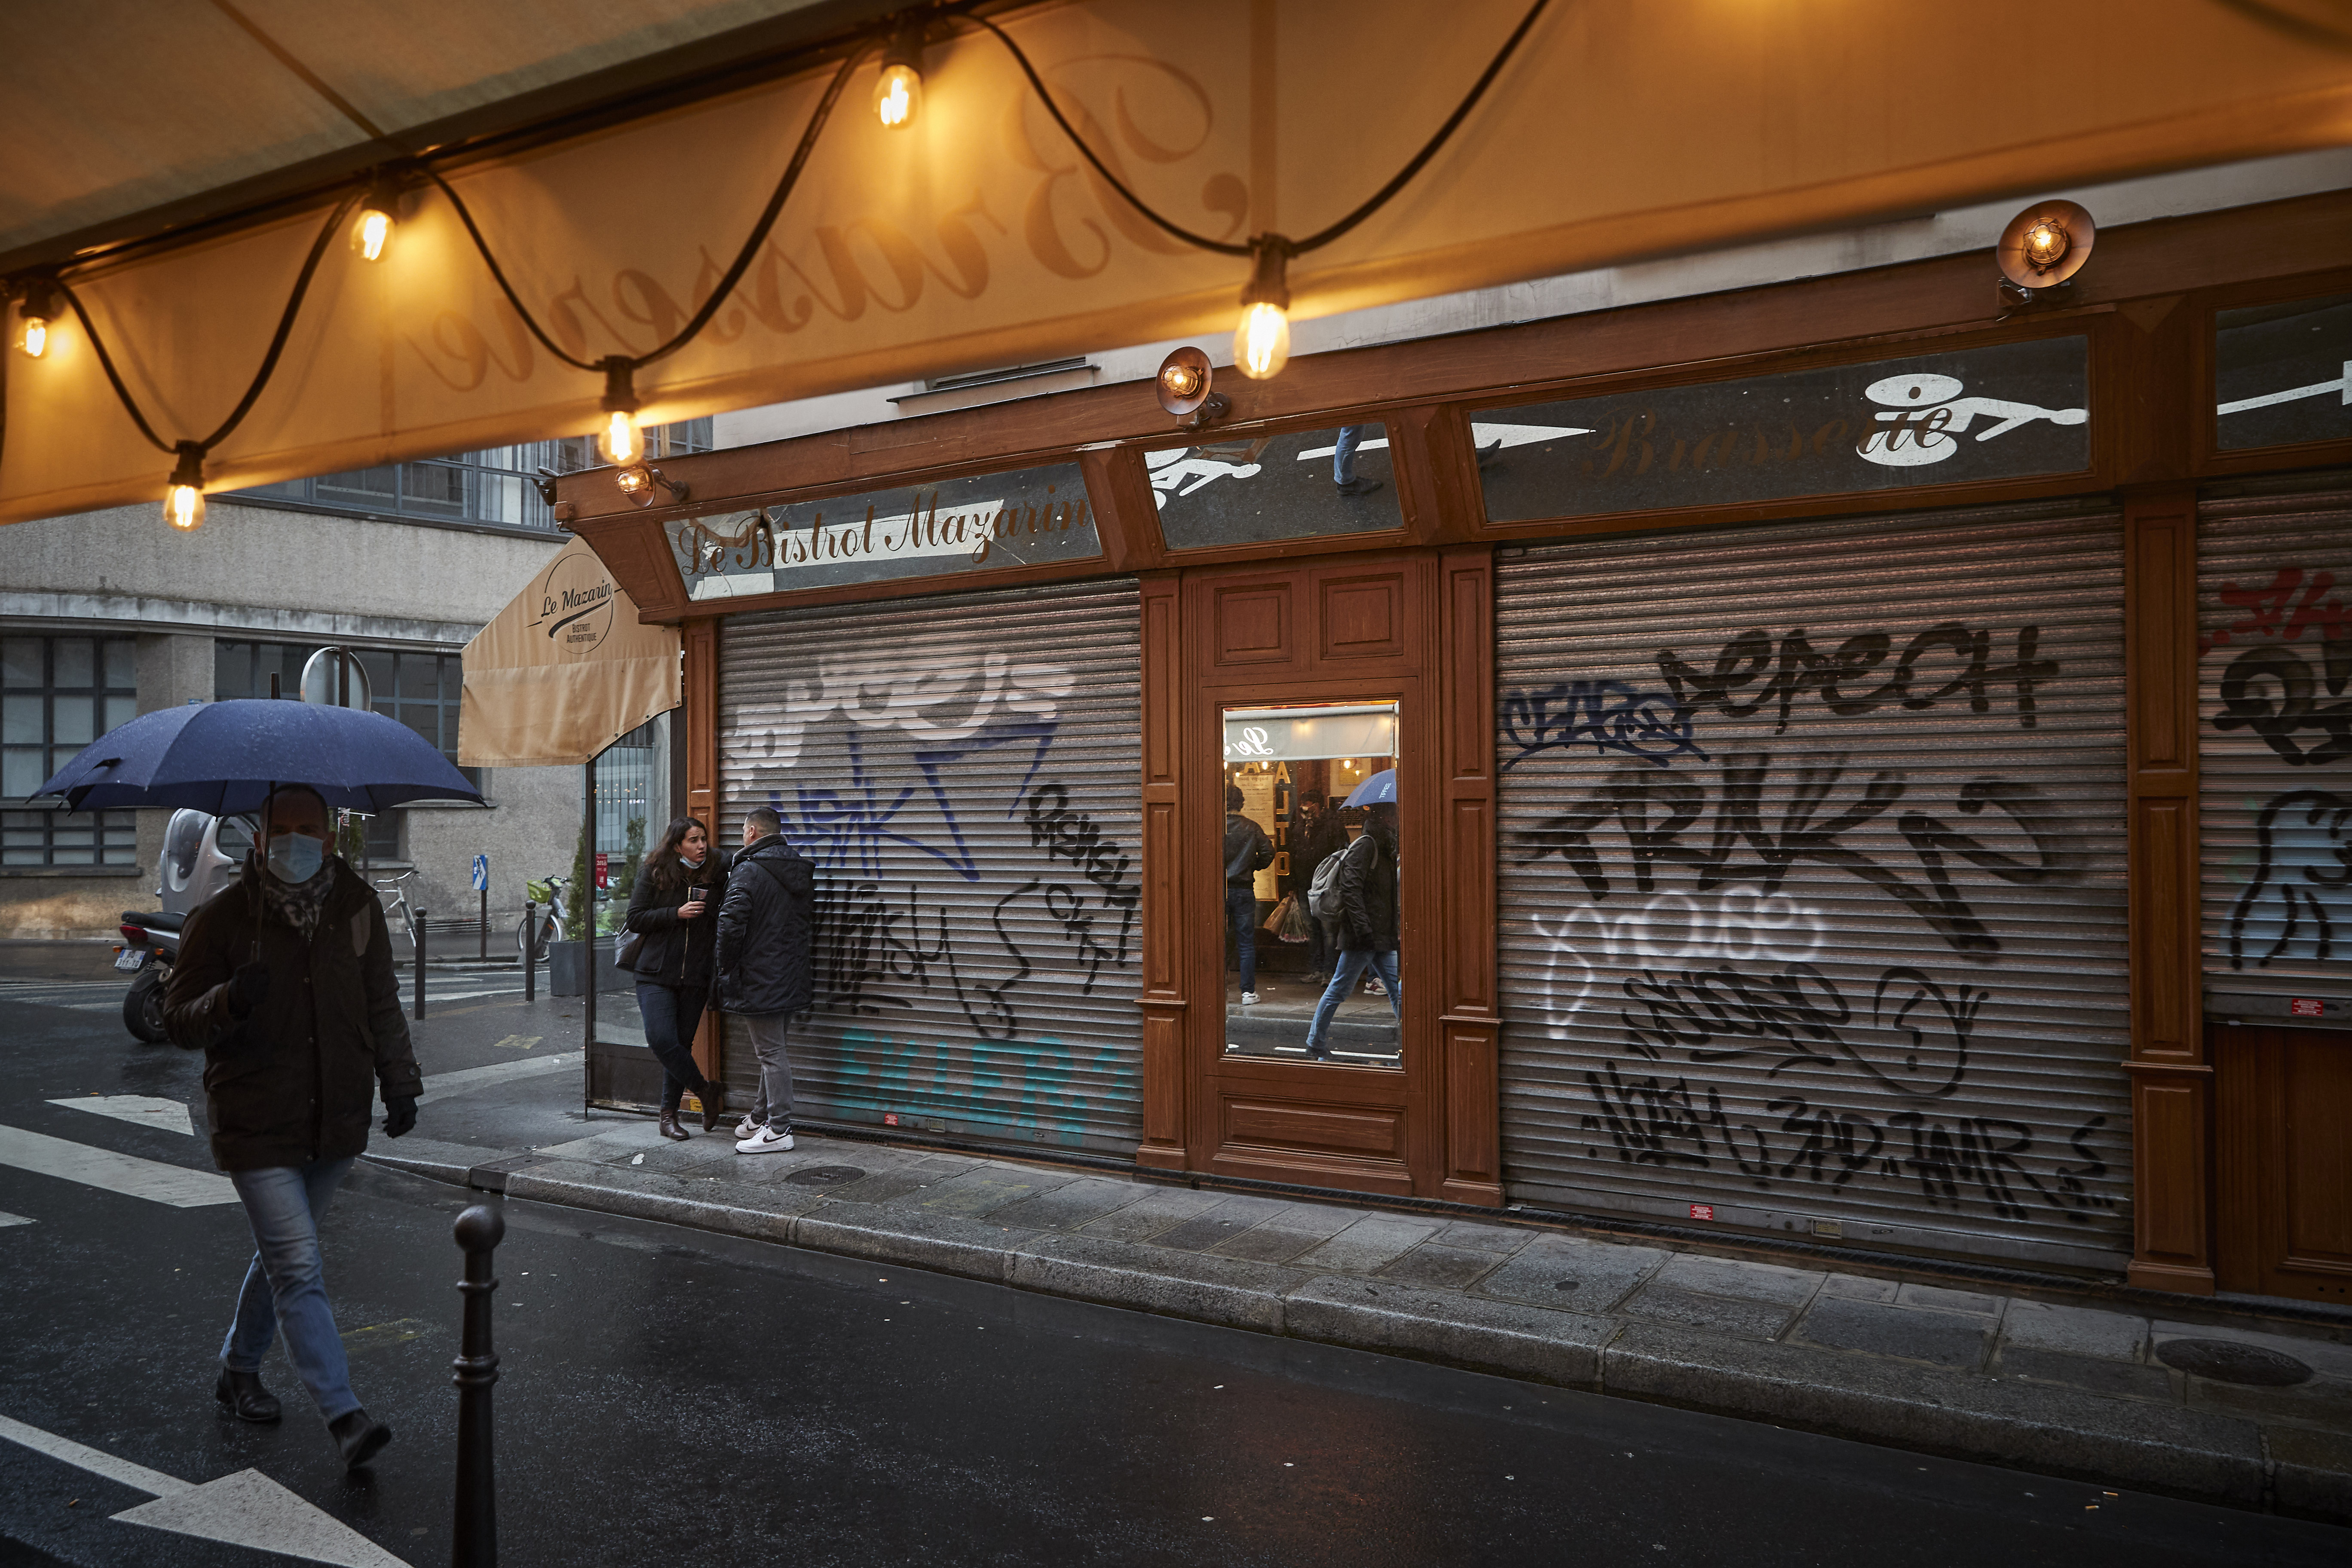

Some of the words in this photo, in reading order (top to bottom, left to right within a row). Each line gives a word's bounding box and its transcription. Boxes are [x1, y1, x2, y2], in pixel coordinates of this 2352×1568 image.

[1580, 386, 1954, 478] Brasserie
[678, 524, 726, 576] Le
[736, 504, 876, 570] Bistrot
[885, 485, 1089, 564] Mazarin
[541, 596, 557, 617] Le
[562, 579, 612, 611] Mazarin
